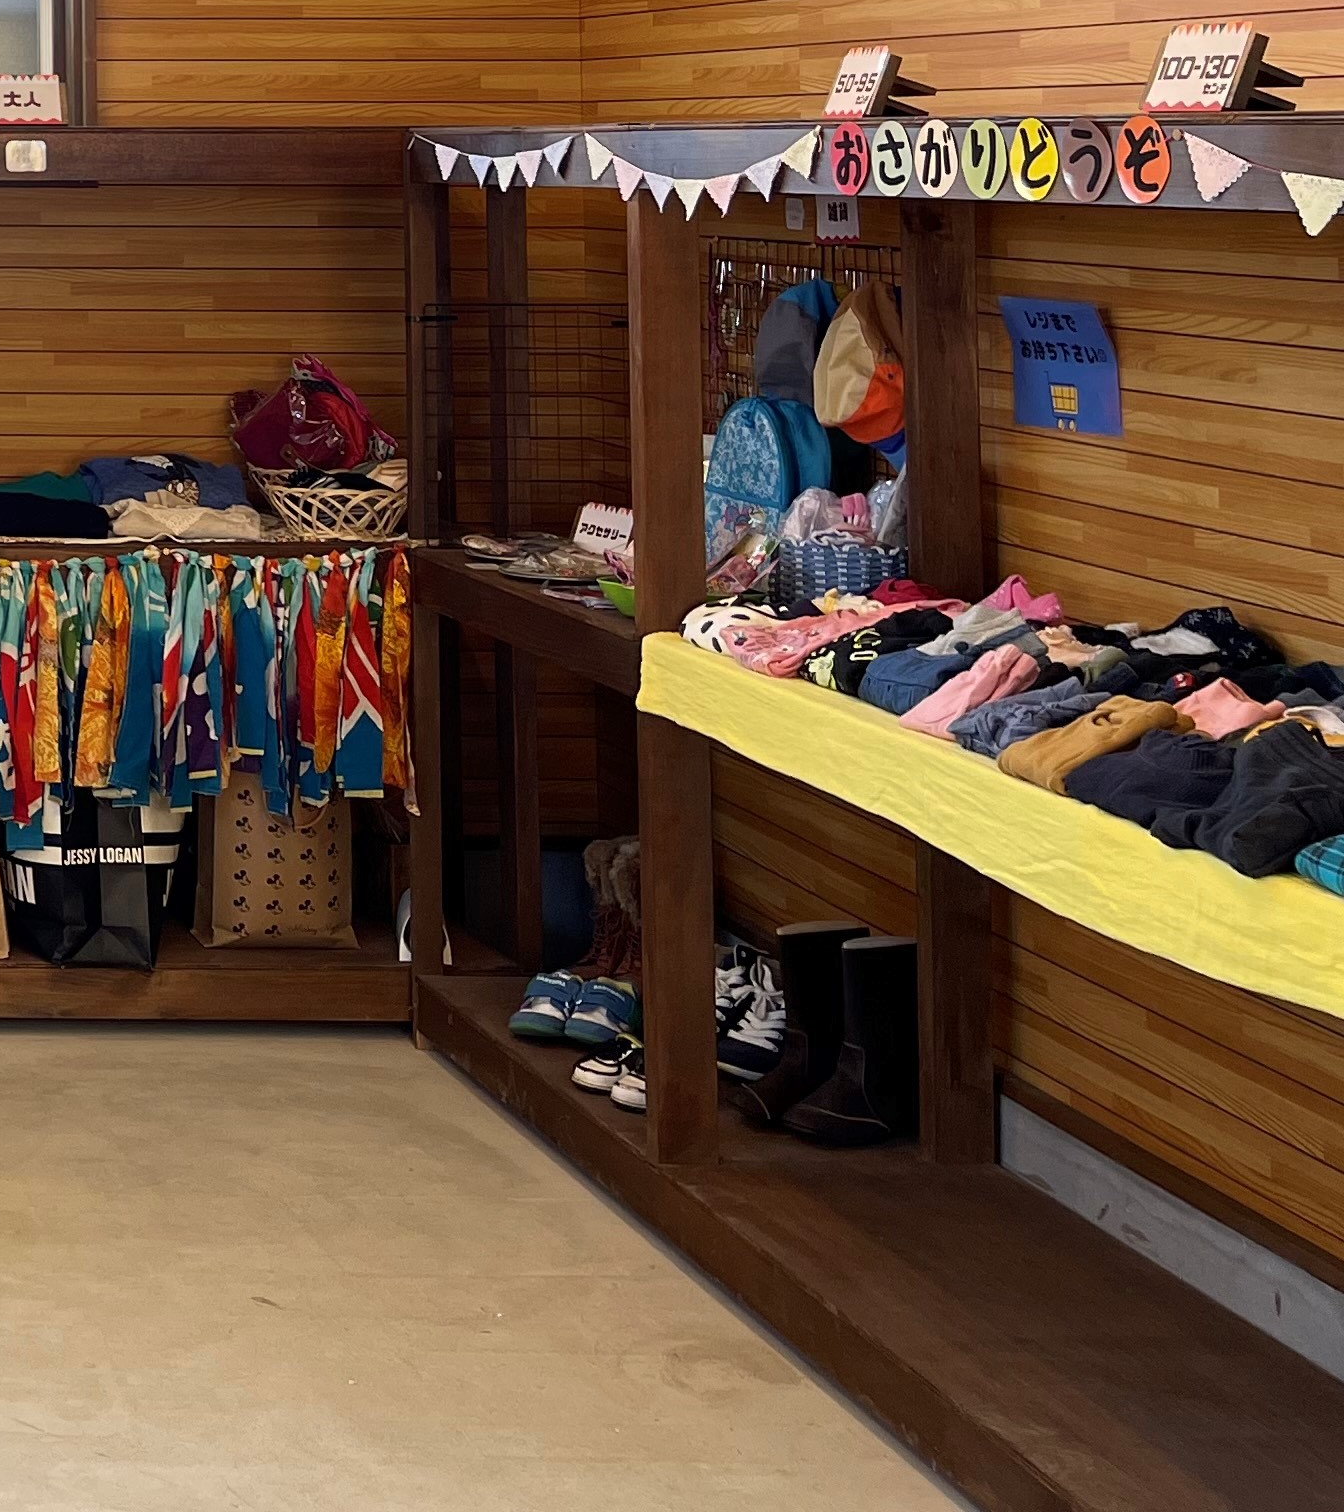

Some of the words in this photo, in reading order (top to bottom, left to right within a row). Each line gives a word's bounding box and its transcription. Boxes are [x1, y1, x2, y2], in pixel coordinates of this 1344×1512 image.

[1158, 55, 1240, 81] 100-130
[834, 73, 879, 94] 50-95
[1202, 82, 1228, 96] センチ
[3, 91, 41, 108] 大人
[834, 125, 1161, 192] おさがりどうぞ
[1024, 310, 1078, 333] レジまで
[1020, 339, 1099, 364] お持ち下さい
[580, 522, 626, 540] アクセサリー
[64, 848, 97, 865] JESSY
[99, 847, 143, 864] LOGAN
